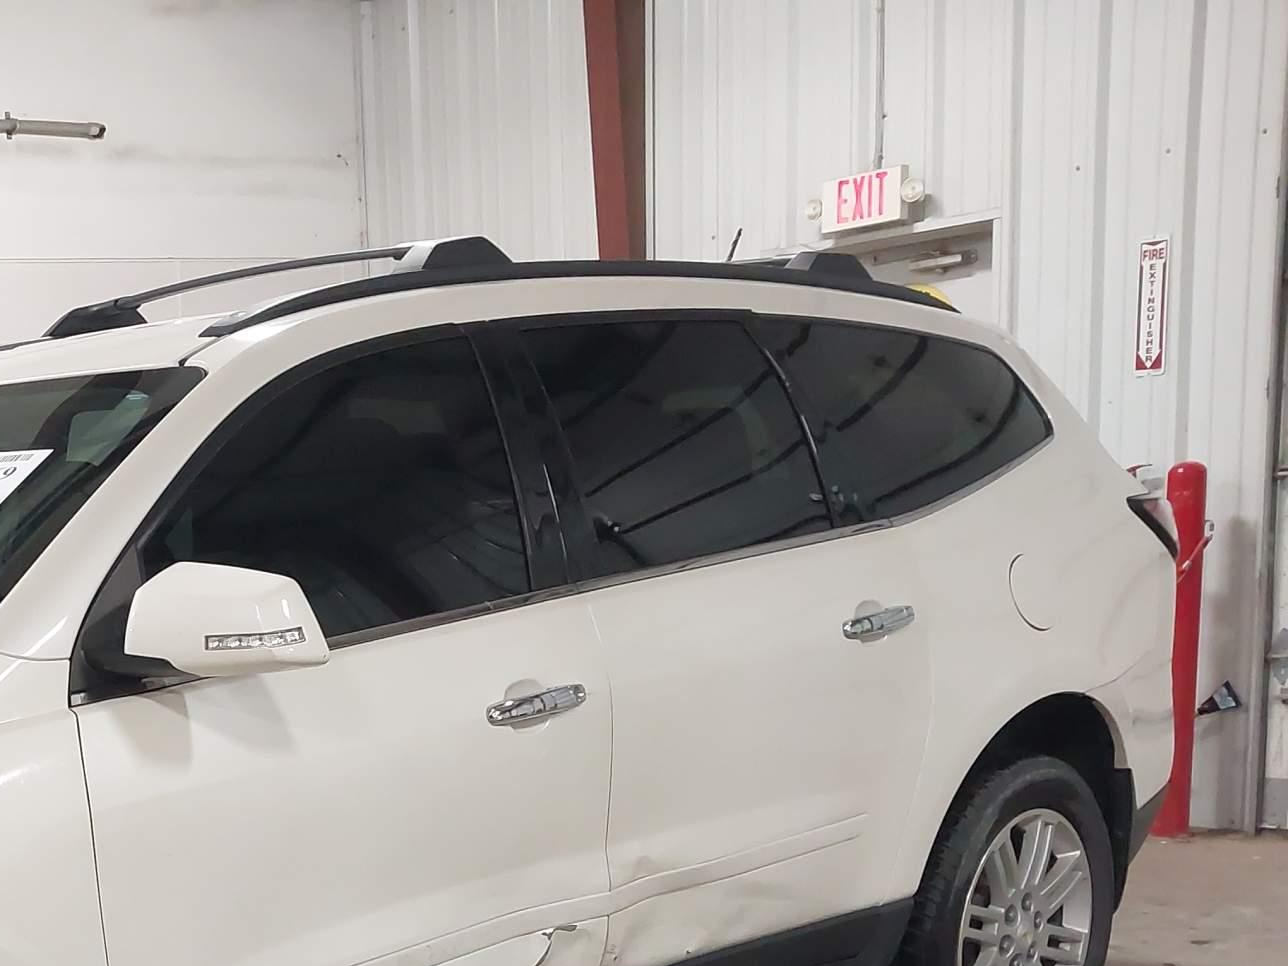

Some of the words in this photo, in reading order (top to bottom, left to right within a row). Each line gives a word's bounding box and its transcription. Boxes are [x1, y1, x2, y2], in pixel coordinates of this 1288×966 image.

[837, 171, 888, 224] EXIT
[1143, 247, 1165, 261] FIRE
[1145, 263, 1157, 362] EXTINGUISHER
